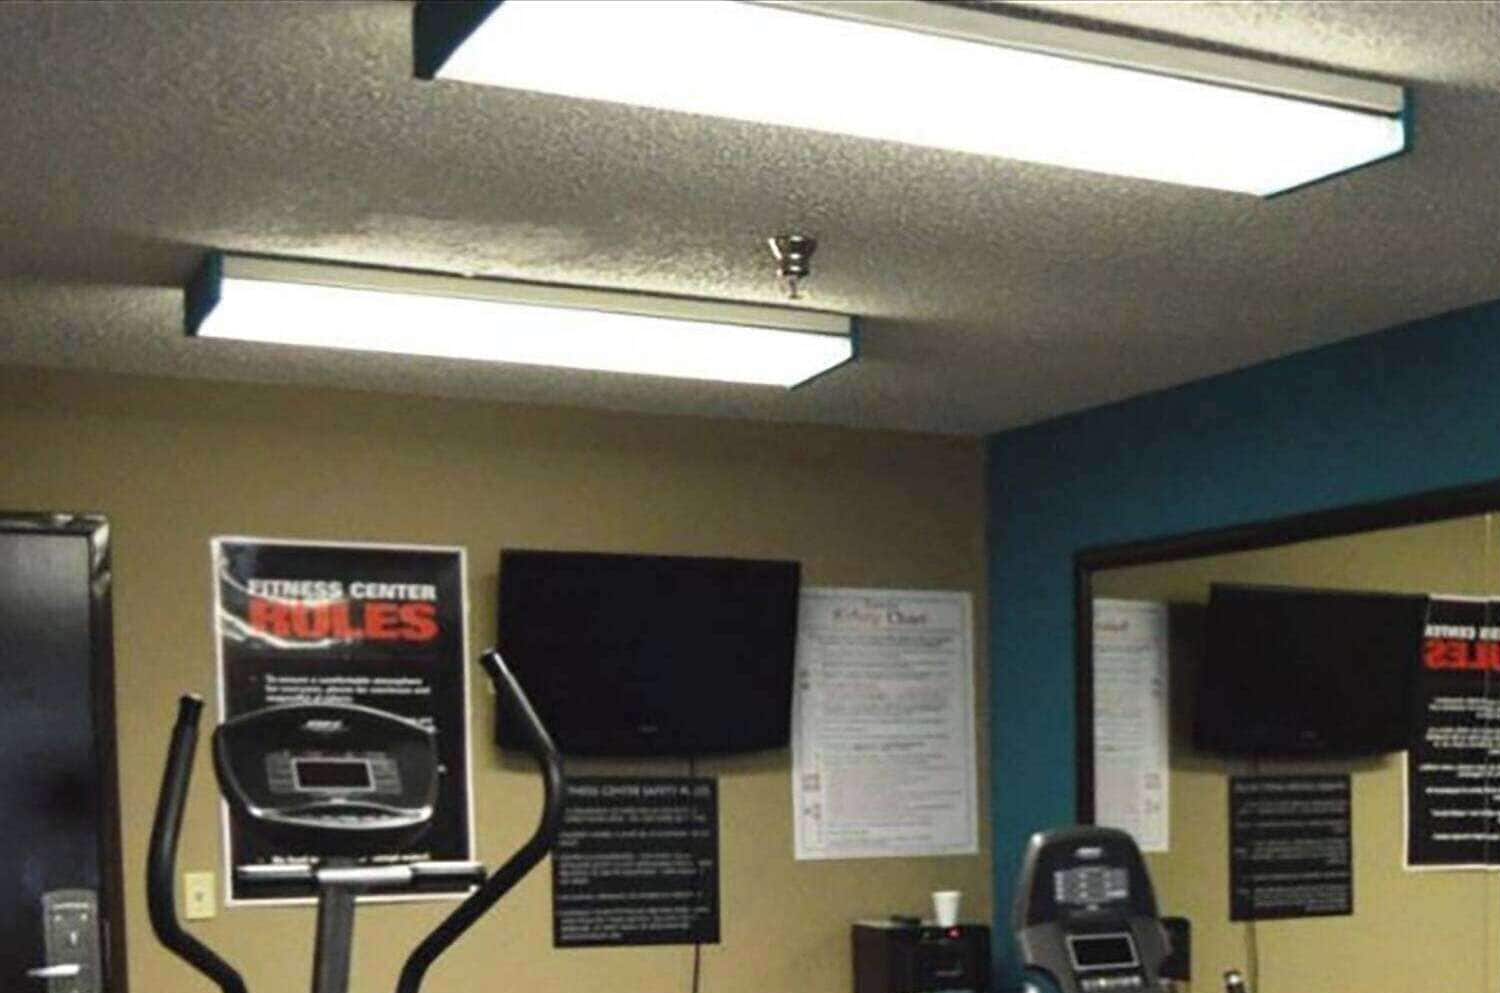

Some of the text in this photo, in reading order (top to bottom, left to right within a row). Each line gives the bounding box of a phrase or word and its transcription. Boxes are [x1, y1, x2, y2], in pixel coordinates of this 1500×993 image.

[247, 579, 438, 600] FITNESS CENTER
[247, 597, 439, 641] RULES
